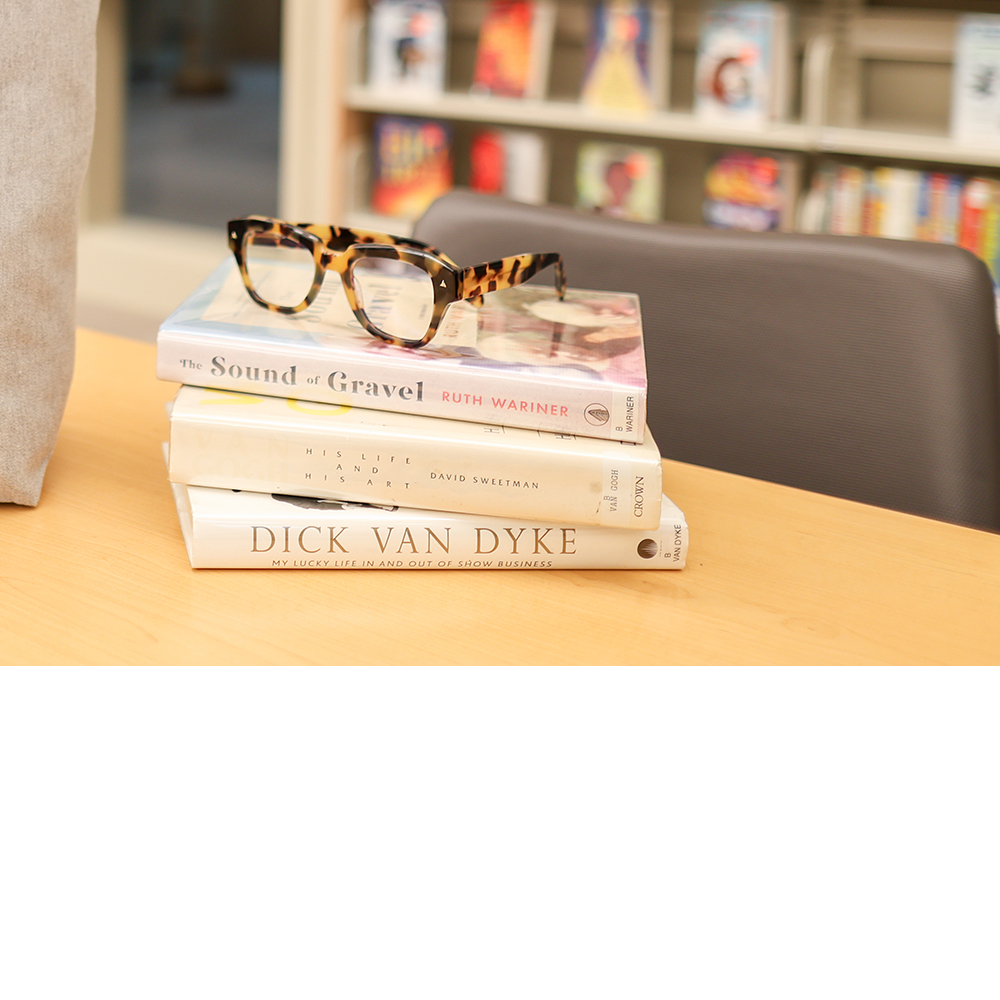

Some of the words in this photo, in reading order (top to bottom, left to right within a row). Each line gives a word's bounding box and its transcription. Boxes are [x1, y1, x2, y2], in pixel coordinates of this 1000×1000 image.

[180, 358, 203, 371] The
[210, 355, 297, 386] Sound
[306, 375, 321, 385] of
[327, 370, 424, 402] Gravel
[442, 391, 483, 406] RUTH
[492, 397, 569, 417] WARINER
[625, 396, 635, 433] WARINER
[305, 448, 342, 458] HIS
[361, 453, 411, 465] LIFE
[336, 463, 379, 474] AND
[305, 473, 345, 483] HIS
[366, 479, 410, 490] ART
[430, 472, 466, 483] DAVID
[472, 476, 539, 490] SWEETMAN
[610, 469, 619, 492] GOGH
[609, 495, 618, 512] VAN
[633, 475, 645, 518] CROWN
[250, 525, 350, 554] DICK
[371, 526, 451, 554] VAN
[474, 527, 577, 555] DYKE
[673, 524, 682, 546] DYKE
[408, 560, 433, 568] OUT
[438, 560, 452, 568] OF
[457, 560, 493, 568] SHOW
[497, 560, 553, 568] BUSINESS
[672, 547, 682, 562] VAN
